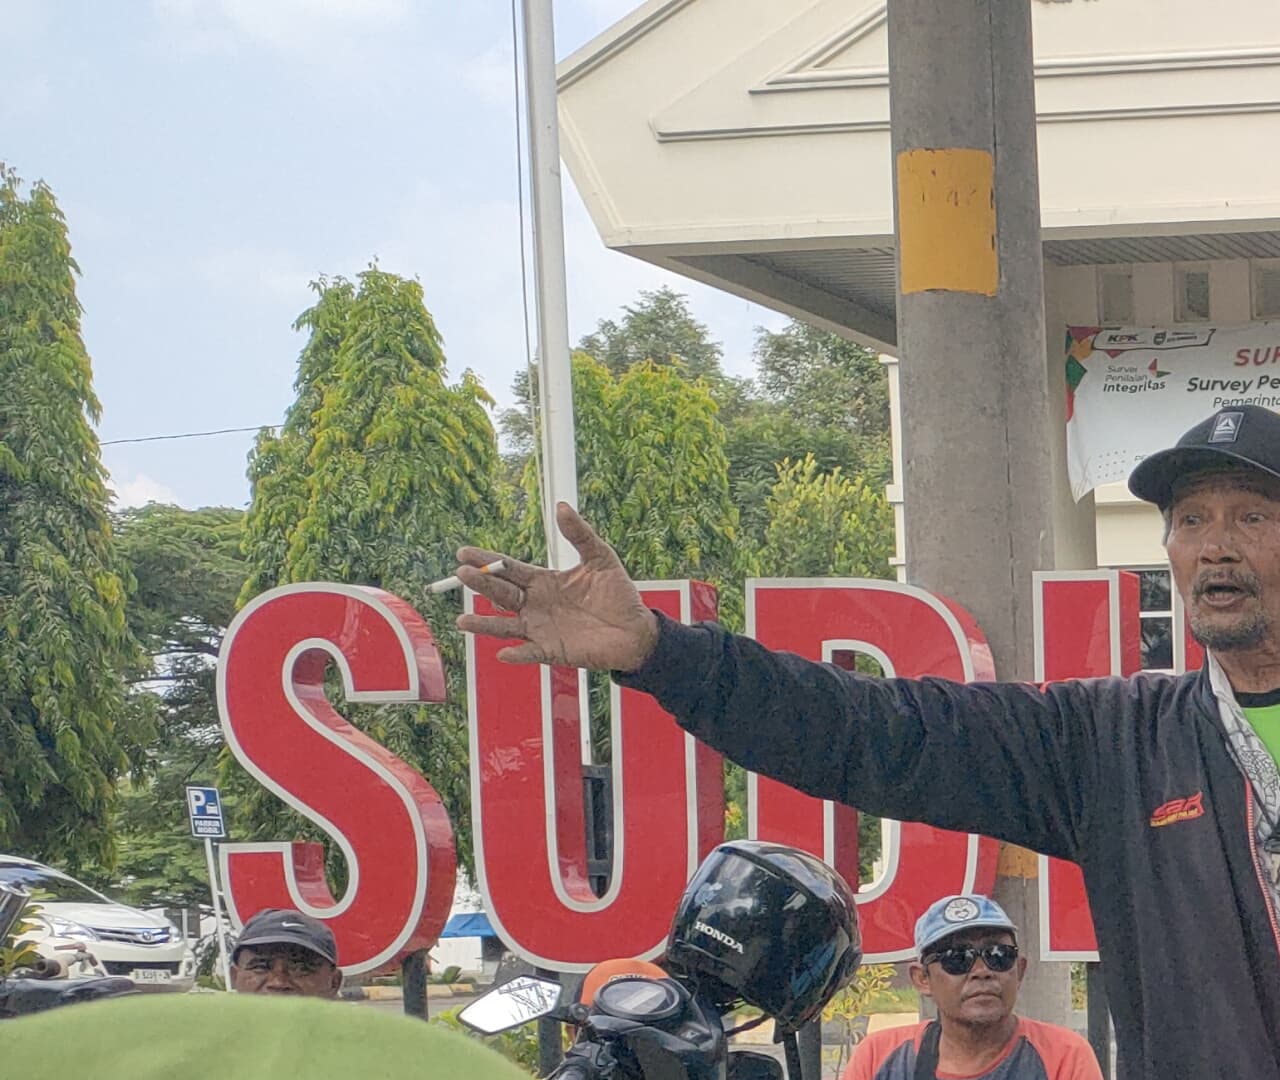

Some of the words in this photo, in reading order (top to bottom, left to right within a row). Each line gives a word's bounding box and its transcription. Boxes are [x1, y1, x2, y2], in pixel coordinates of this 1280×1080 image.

[1108, 334, 1139, 342] KPK
[1103, 380, 1166, 394] Integritas
[1186, 375, 1252, 394] Survey
[190, 790, 206, 815] P
[694, 921, 744, 954] HONDA
